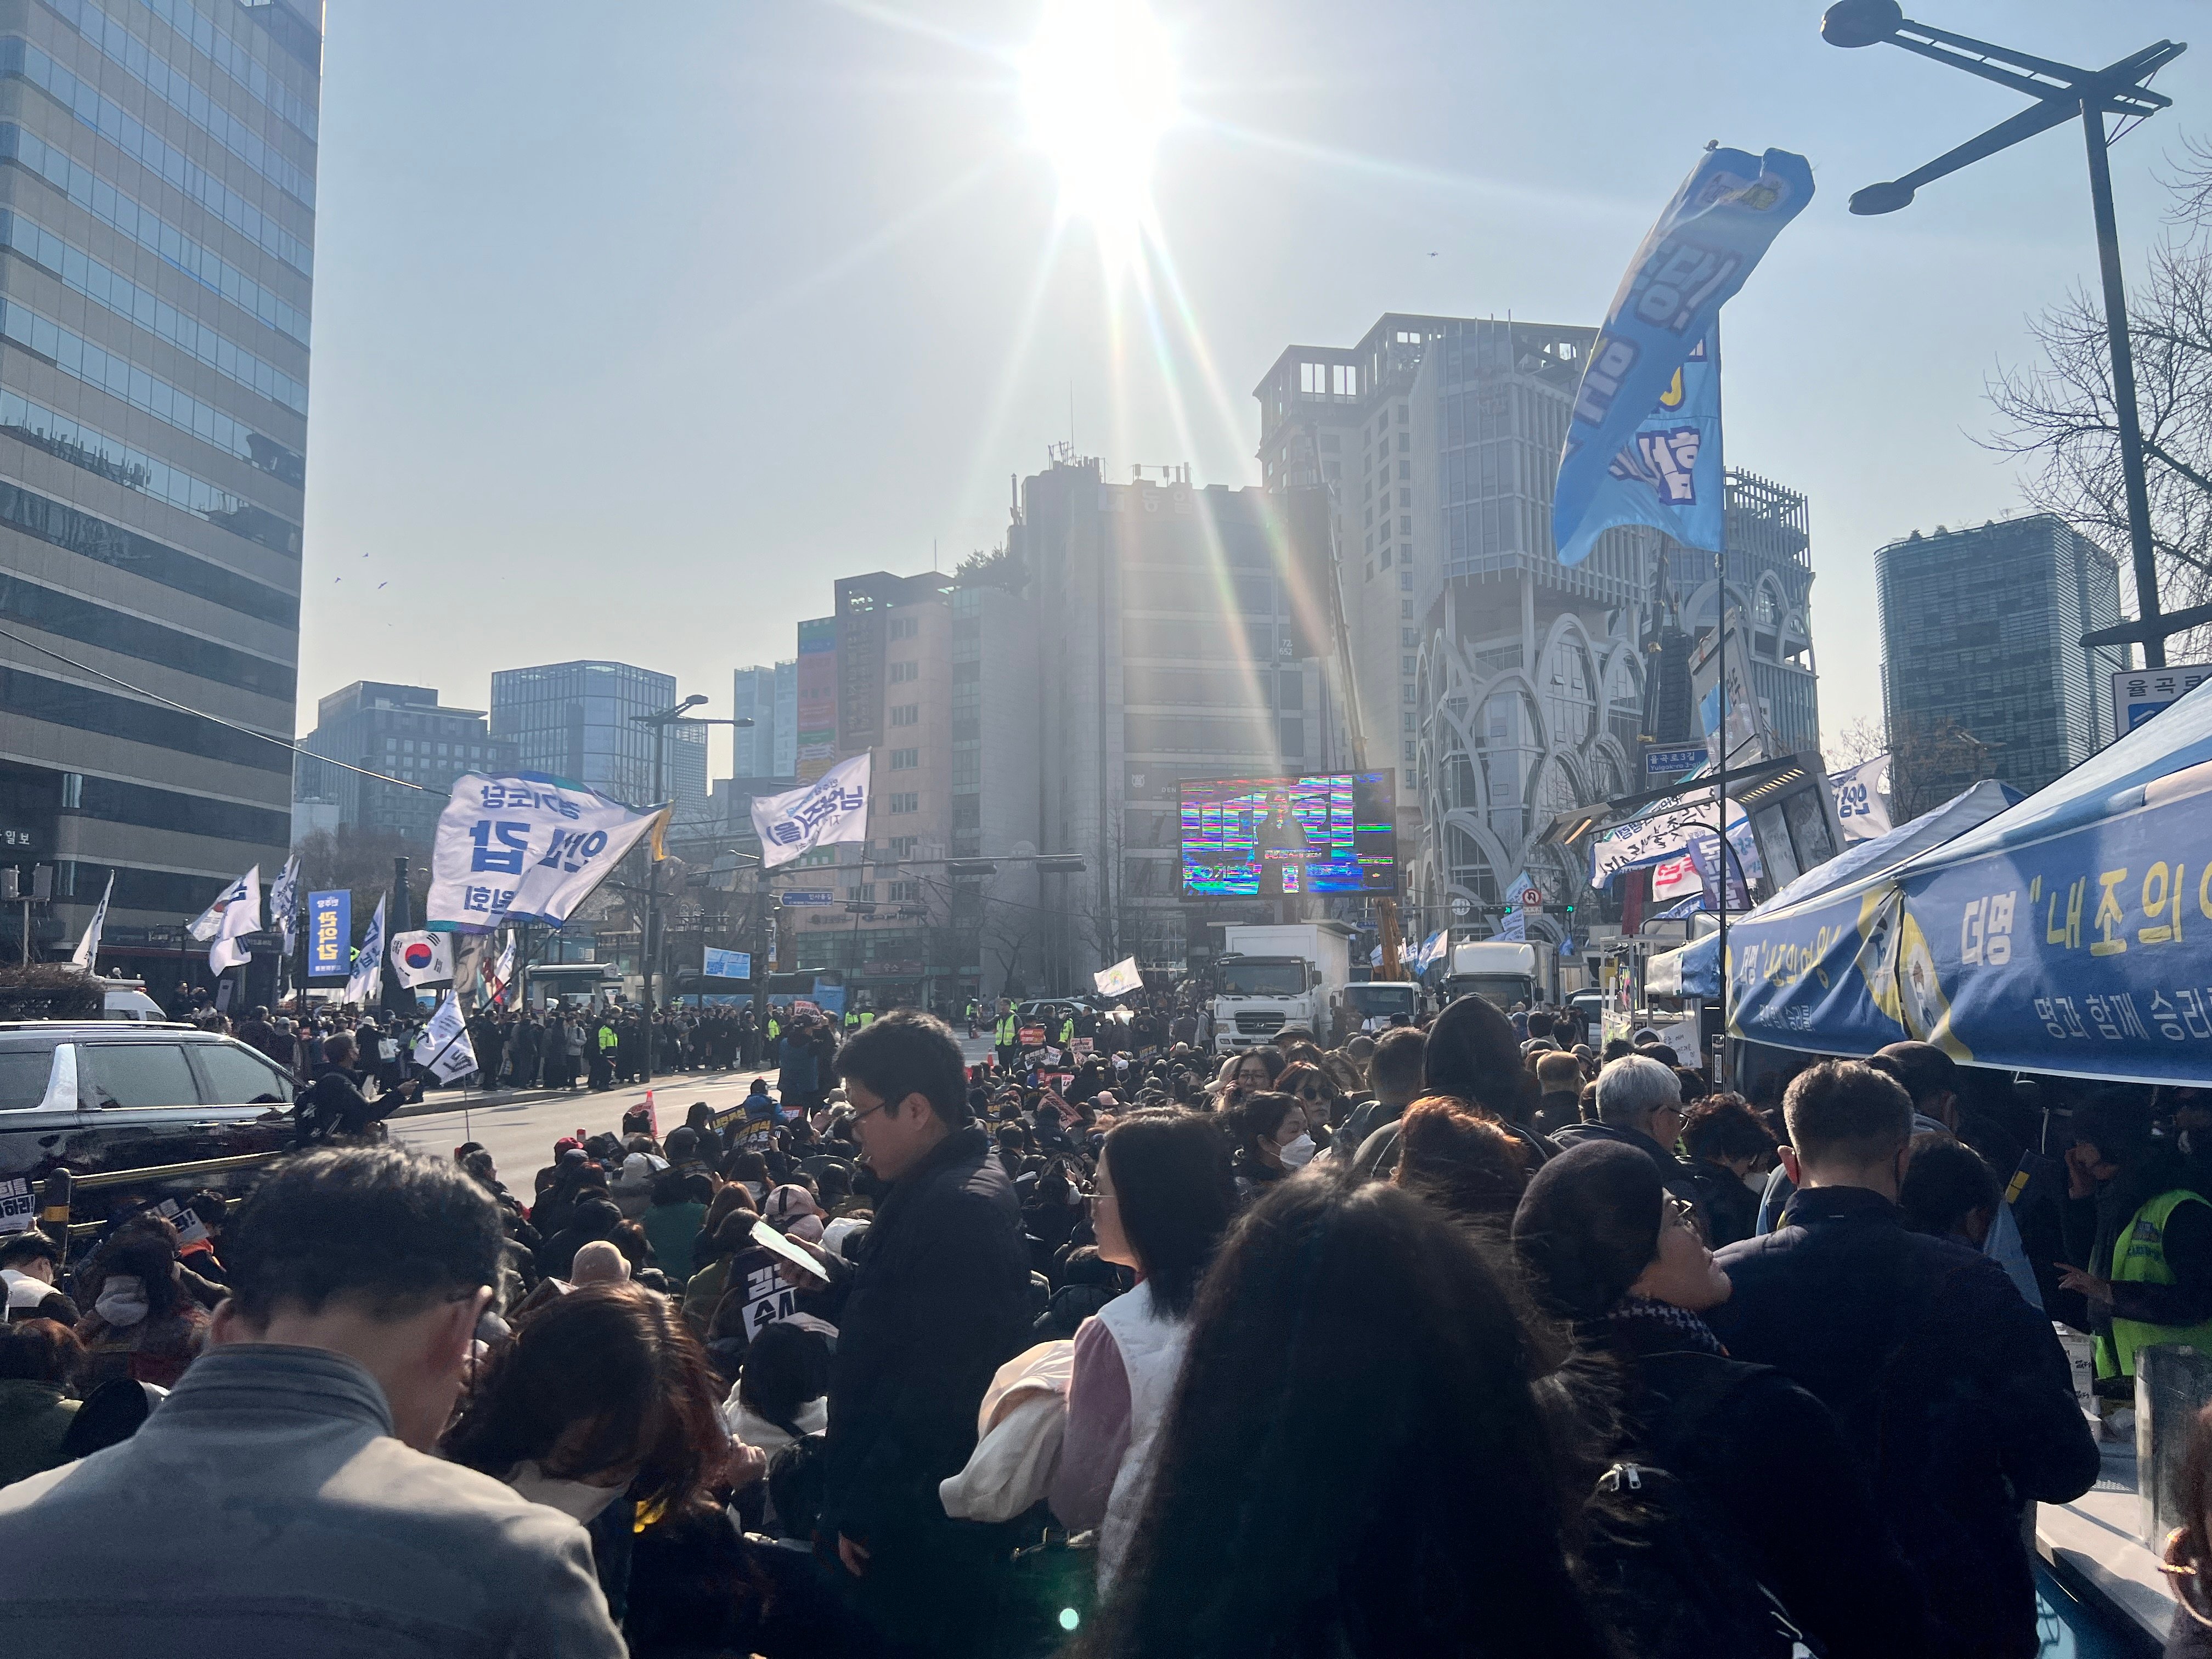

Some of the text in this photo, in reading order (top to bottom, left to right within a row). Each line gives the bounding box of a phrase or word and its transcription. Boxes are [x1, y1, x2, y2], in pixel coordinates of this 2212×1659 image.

[1650, 752, 1695, 764] 율곡로3길
[1650, 764, 1683, 772] Yulgok-ro
[0, 829, 30, 845] 일보
[1962, 890, 2017, 967] 더명
[1740, 945, 1759, 985] 더명
[2034, 986, 2212, 1041] 명과 함께 승리
[0, 1195, 34, 1218] 하라!
